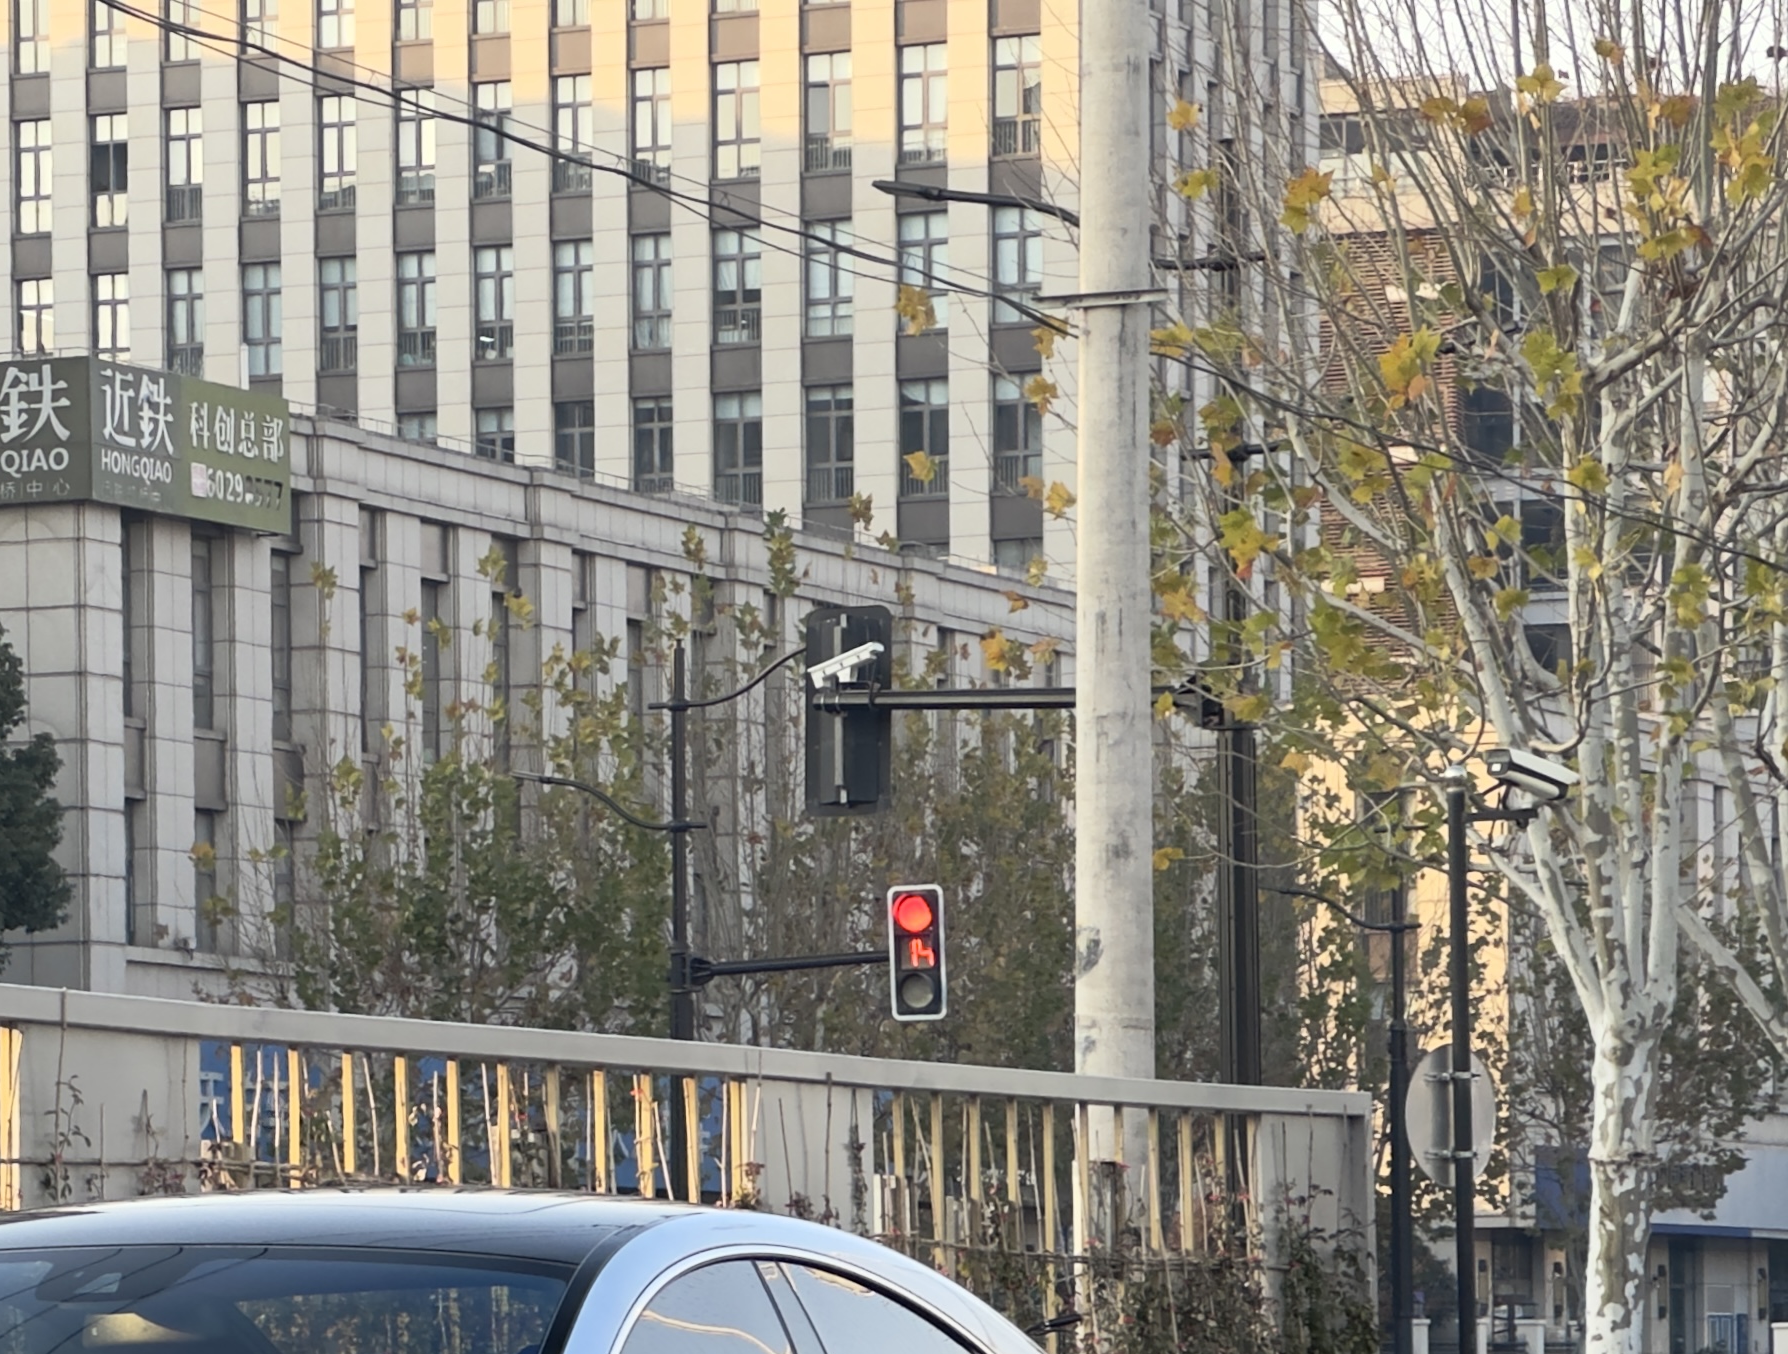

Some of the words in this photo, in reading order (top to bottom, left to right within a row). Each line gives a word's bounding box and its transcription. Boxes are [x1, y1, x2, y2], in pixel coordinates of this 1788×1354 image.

[190, 402, 284, 464] 科创总部
[101, 449, 172, 486] HONGQIAO
